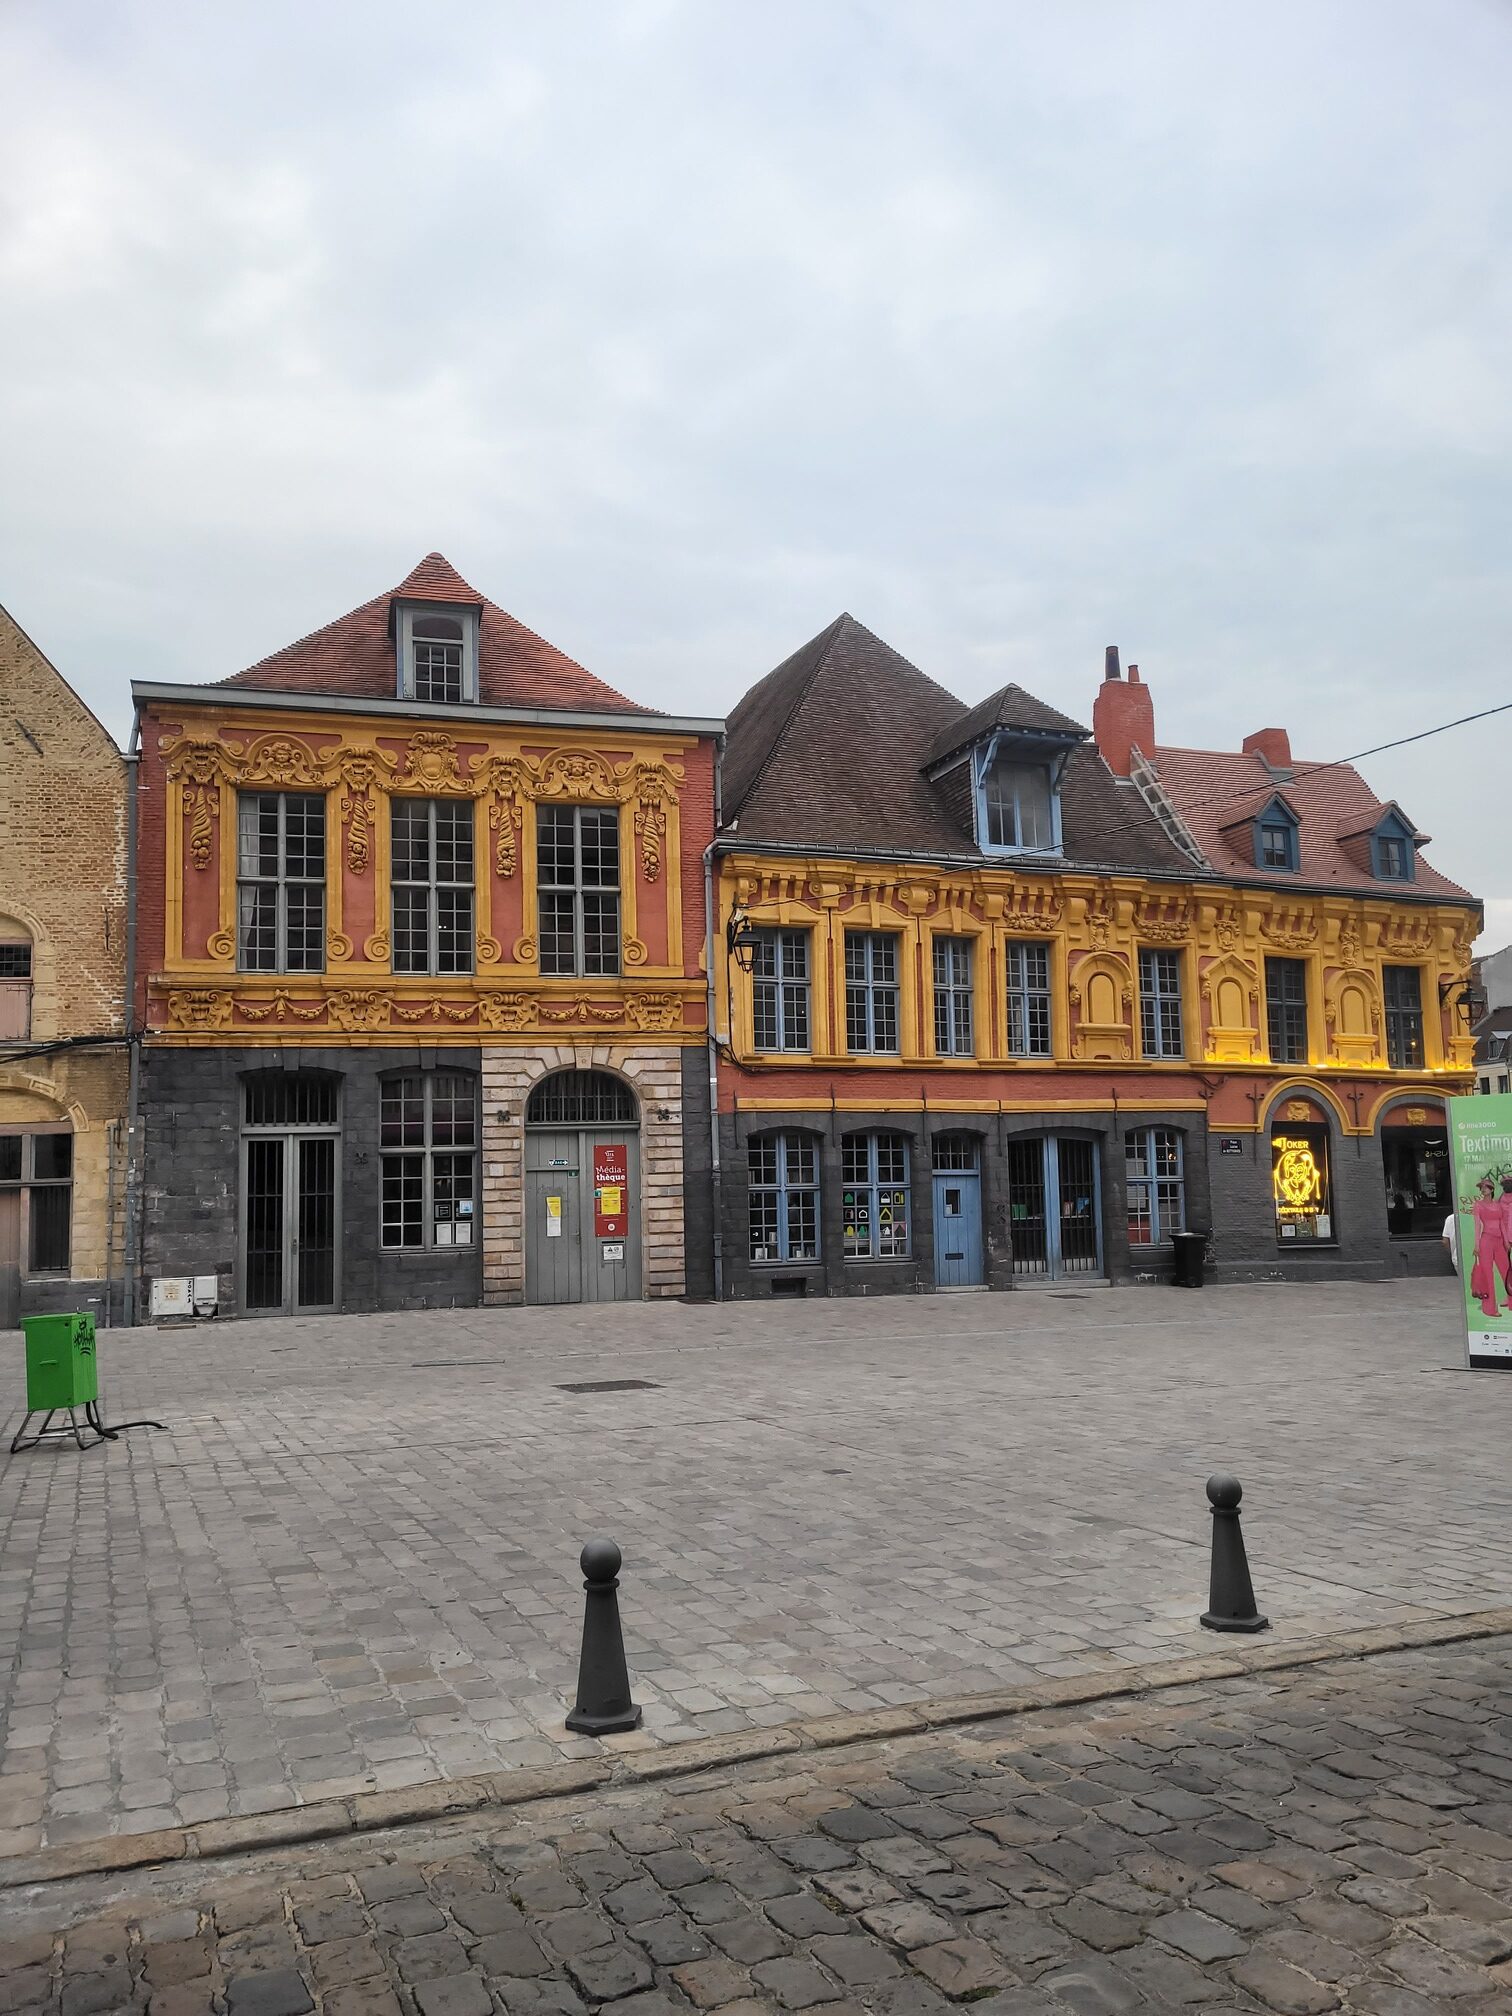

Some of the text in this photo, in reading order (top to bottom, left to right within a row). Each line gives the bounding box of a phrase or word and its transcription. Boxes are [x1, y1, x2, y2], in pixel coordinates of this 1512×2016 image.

[1280, 1137, 1309, 1152] JOKER
[595, 1165, 626, 1175] Média-
[596, 1174, 626, 1182] thèque
